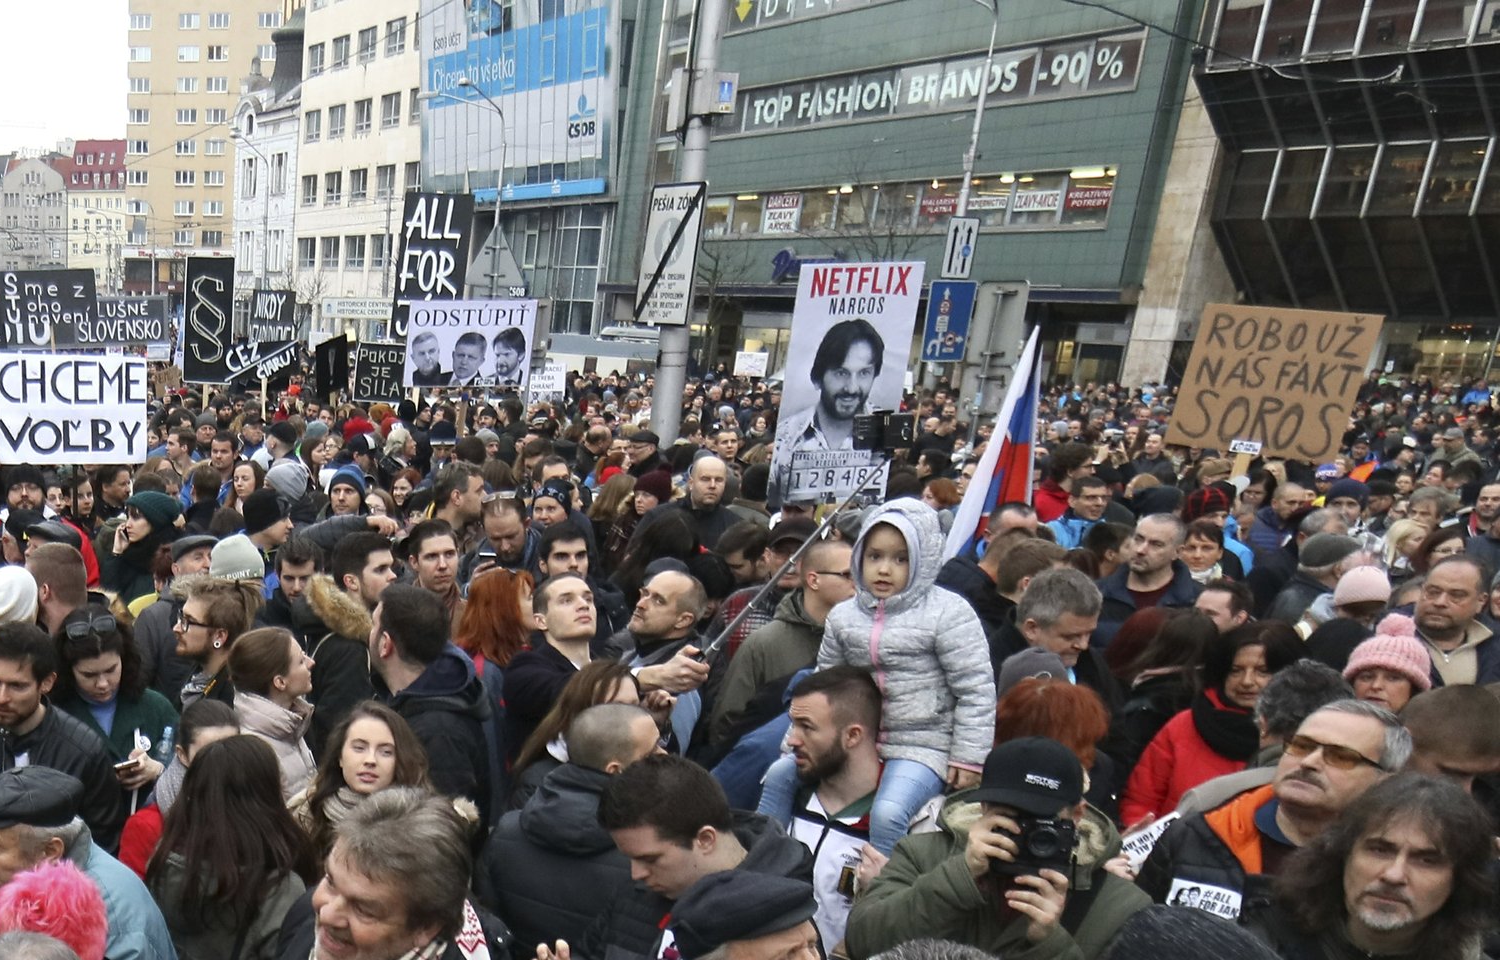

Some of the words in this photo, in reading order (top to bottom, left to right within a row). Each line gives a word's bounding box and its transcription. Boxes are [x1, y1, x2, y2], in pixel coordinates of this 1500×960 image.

[467, 65, 478, 85] to
[481, 54, 515, 83] všetko
[754, 95, 793, 125] TOP
[797, 79, 901, 120] FASHION
[908, 61, 1019, 105] BRANDS
[1038, 51, 1087, 86] -90
[1097, 46, 1124, 80] %
[568, 121, 595, 138] ČSOB
[652, 194, 675, 211] PEŠIA
[406, 197, 461, 242] ALL
[400, 249, 458, 296] FOR
[810, 266, 912, 299] NETFLIX
[97, 301, 149, 319] LUŠNÉ
[254, 292, 287, 322] NIKDY
[414, 303, 530, 328] ODSTÚPIŤ
[829, 297, 885, 316] NARCOS
[78, 319, 162, 343] SLOVENSKO
[1206, 311, 1309, 353] ROBO
[1316, 316, 1366, 359] UŽ
[225, 341, 261, 374] CEZ
[359, 349, 406, 365] POKOJ
[371, 366, 391, 379] JE
[360, 378, 400, 398] SILA
[1175, 388, 1344, 458] SOROS
[1203, 889, 1232, 905] #ALL
